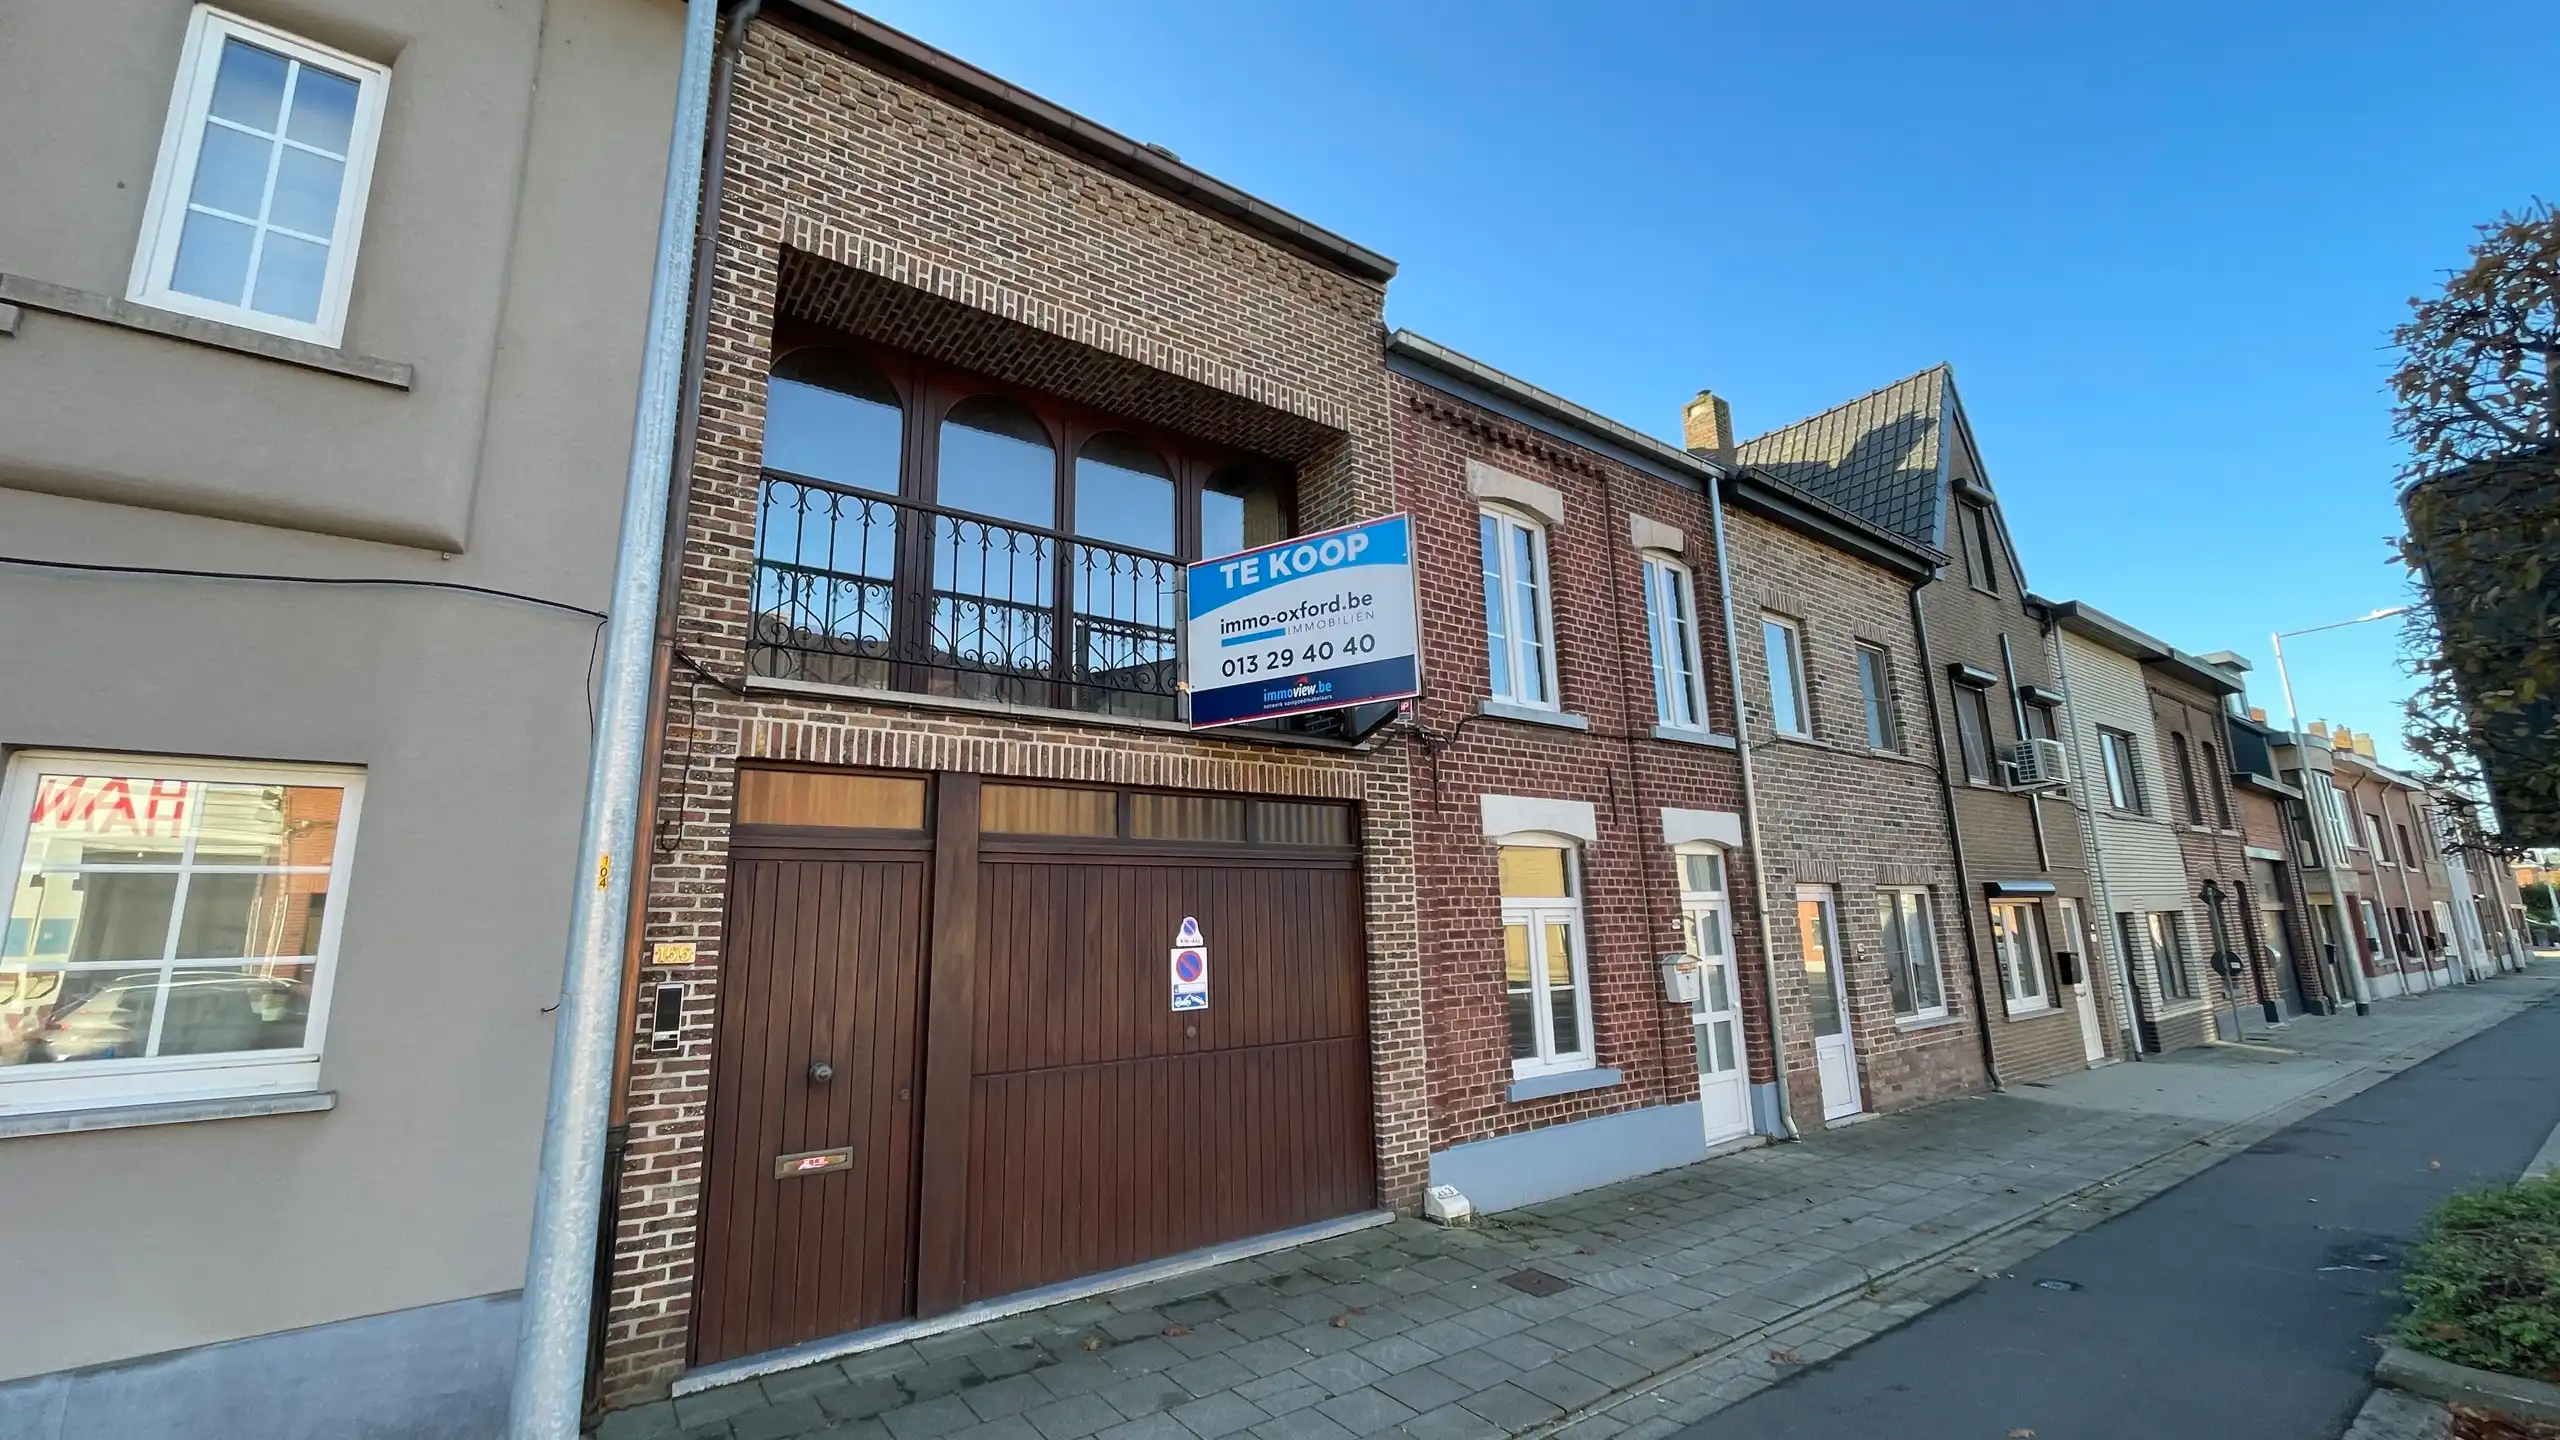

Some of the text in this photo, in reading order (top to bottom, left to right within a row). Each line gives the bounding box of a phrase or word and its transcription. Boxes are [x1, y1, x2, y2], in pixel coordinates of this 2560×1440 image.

[1220, 533, 1369, 589] TE KOOP
[1220, 592, 1373, 635] immo-oxford.be
[1287, 610, 1375, 635] IMMOBILIEN
[1222, 633, 1375, 677] 013 29 40 40
[1264, 681, 1332, 702] immoview.be
